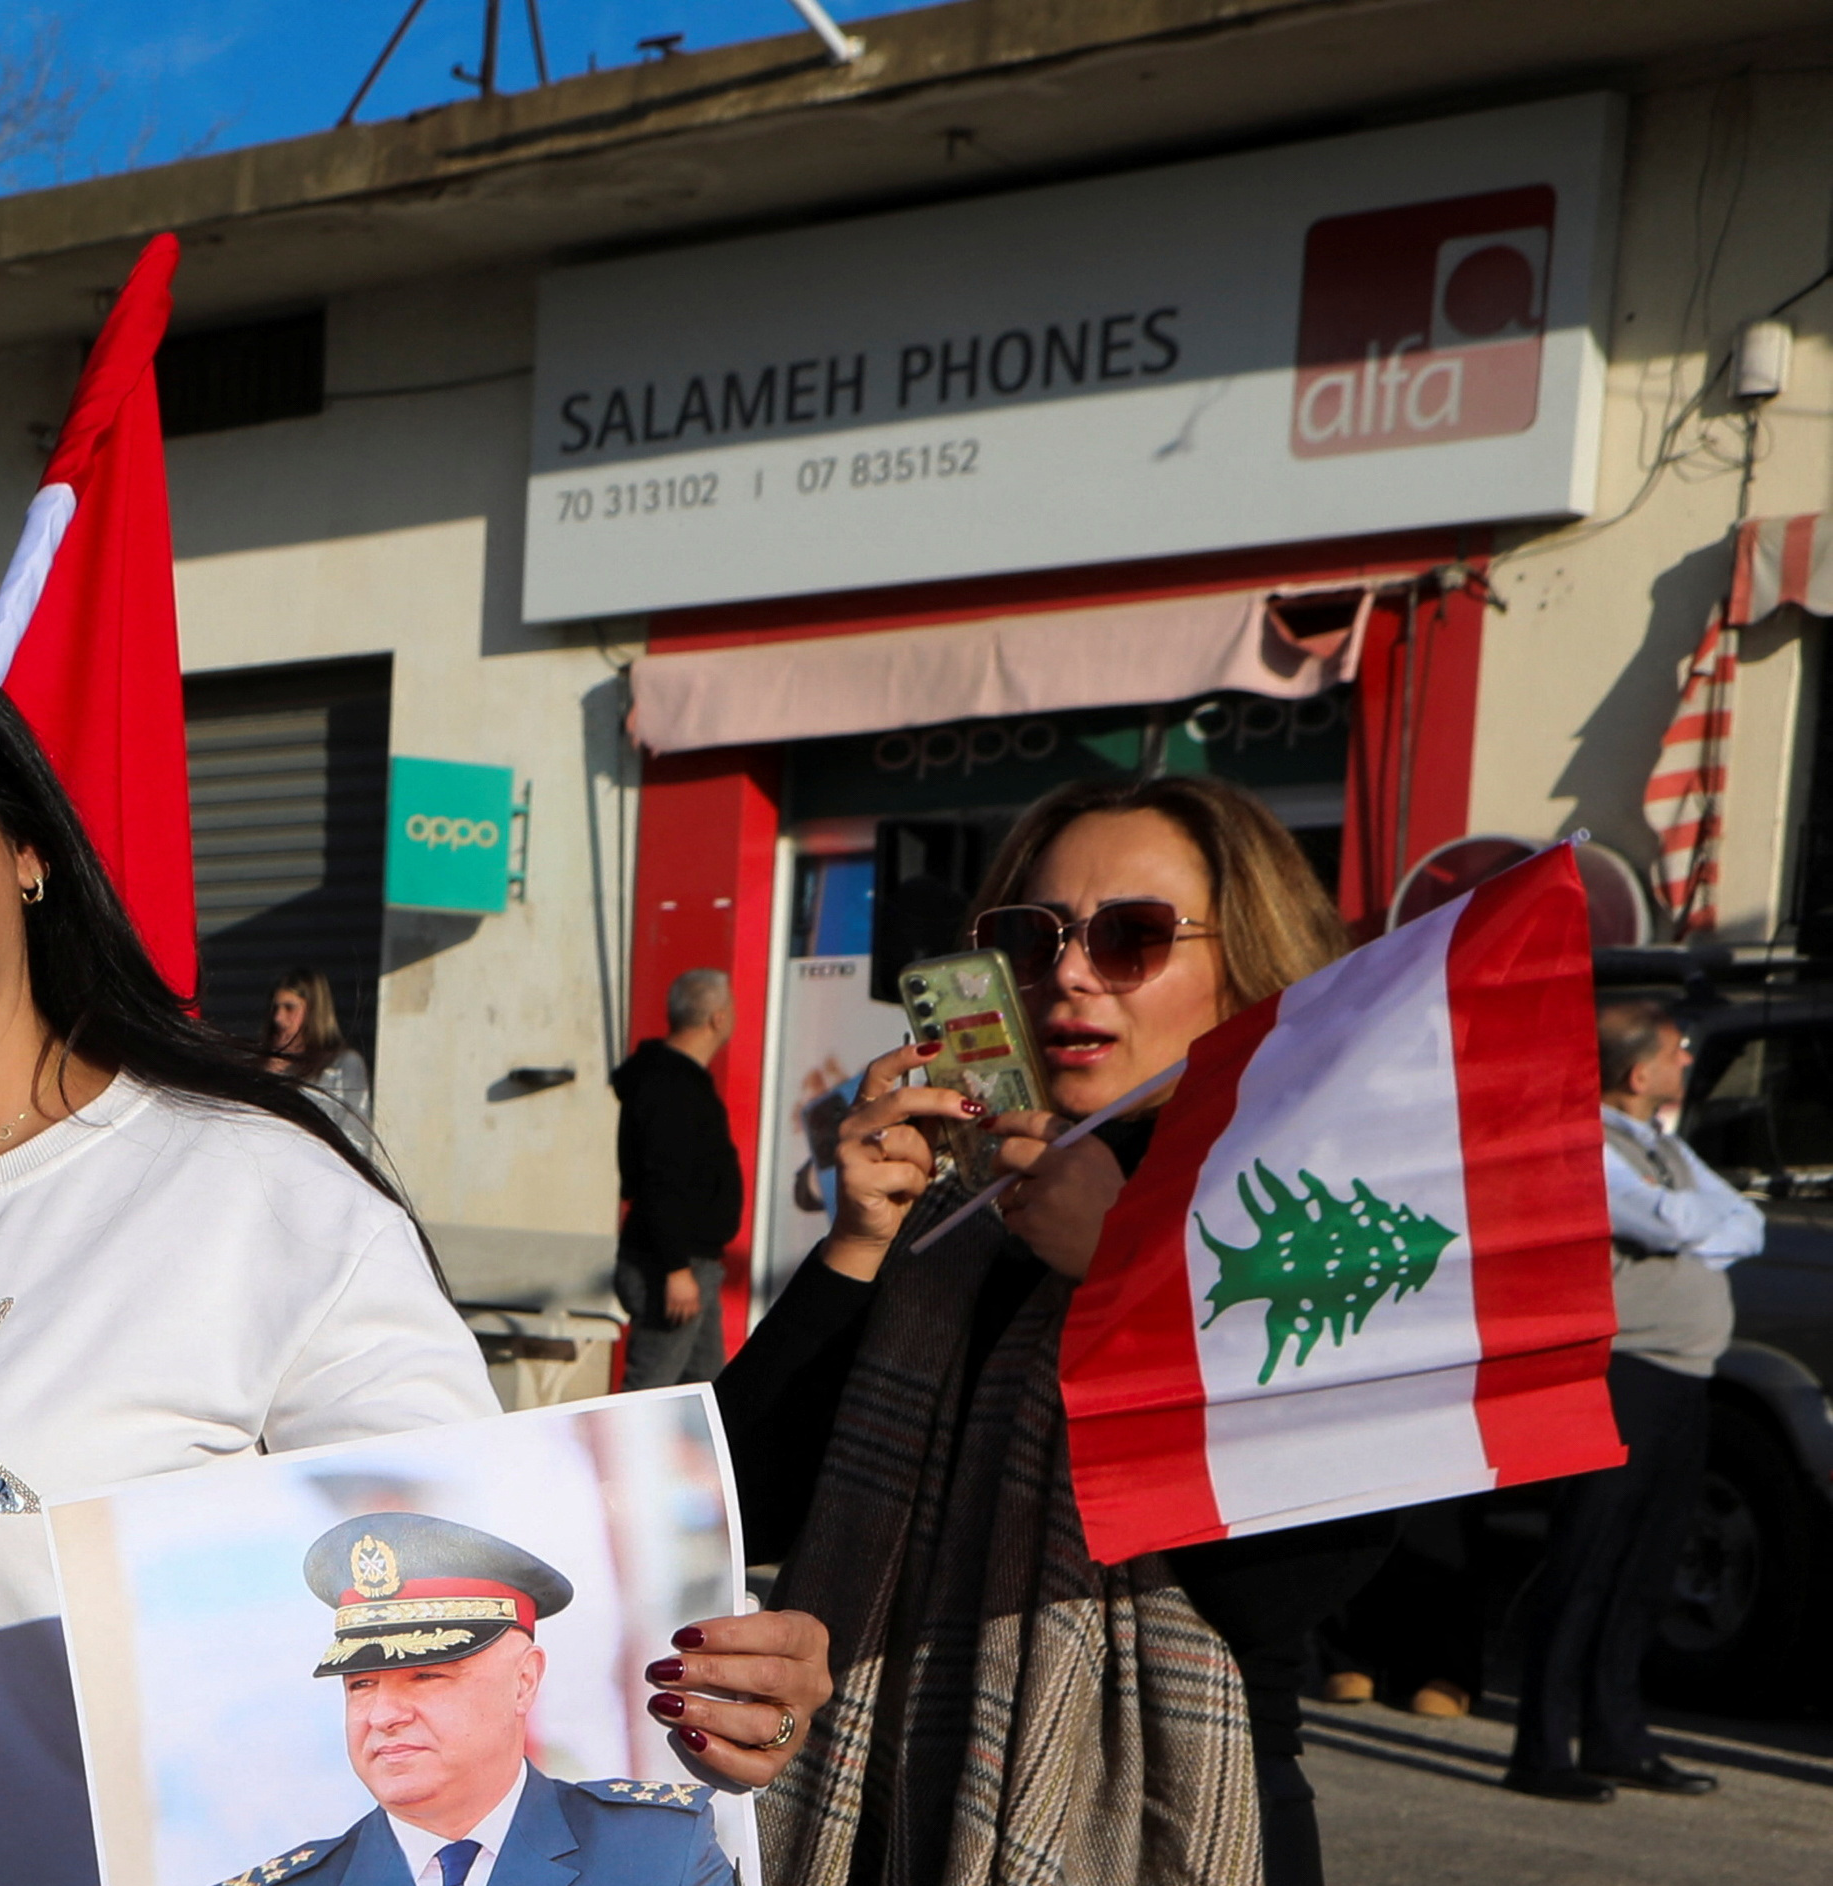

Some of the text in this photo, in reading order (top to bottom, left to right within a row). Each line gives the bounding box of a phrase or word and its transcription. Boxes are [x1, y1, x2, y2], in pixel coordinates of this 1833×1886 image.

[559, 307, 1181, 455] SALAMEH PHONES
[1296, 332, 1464, 443] alfa
[556, 490, 593, 522] 70
[602, 472, 720, 518] 313102
[796, 459, 836, 494] 07
[850, 438, 981, 489] 835152
[405, 813, 499, 852] oppo
